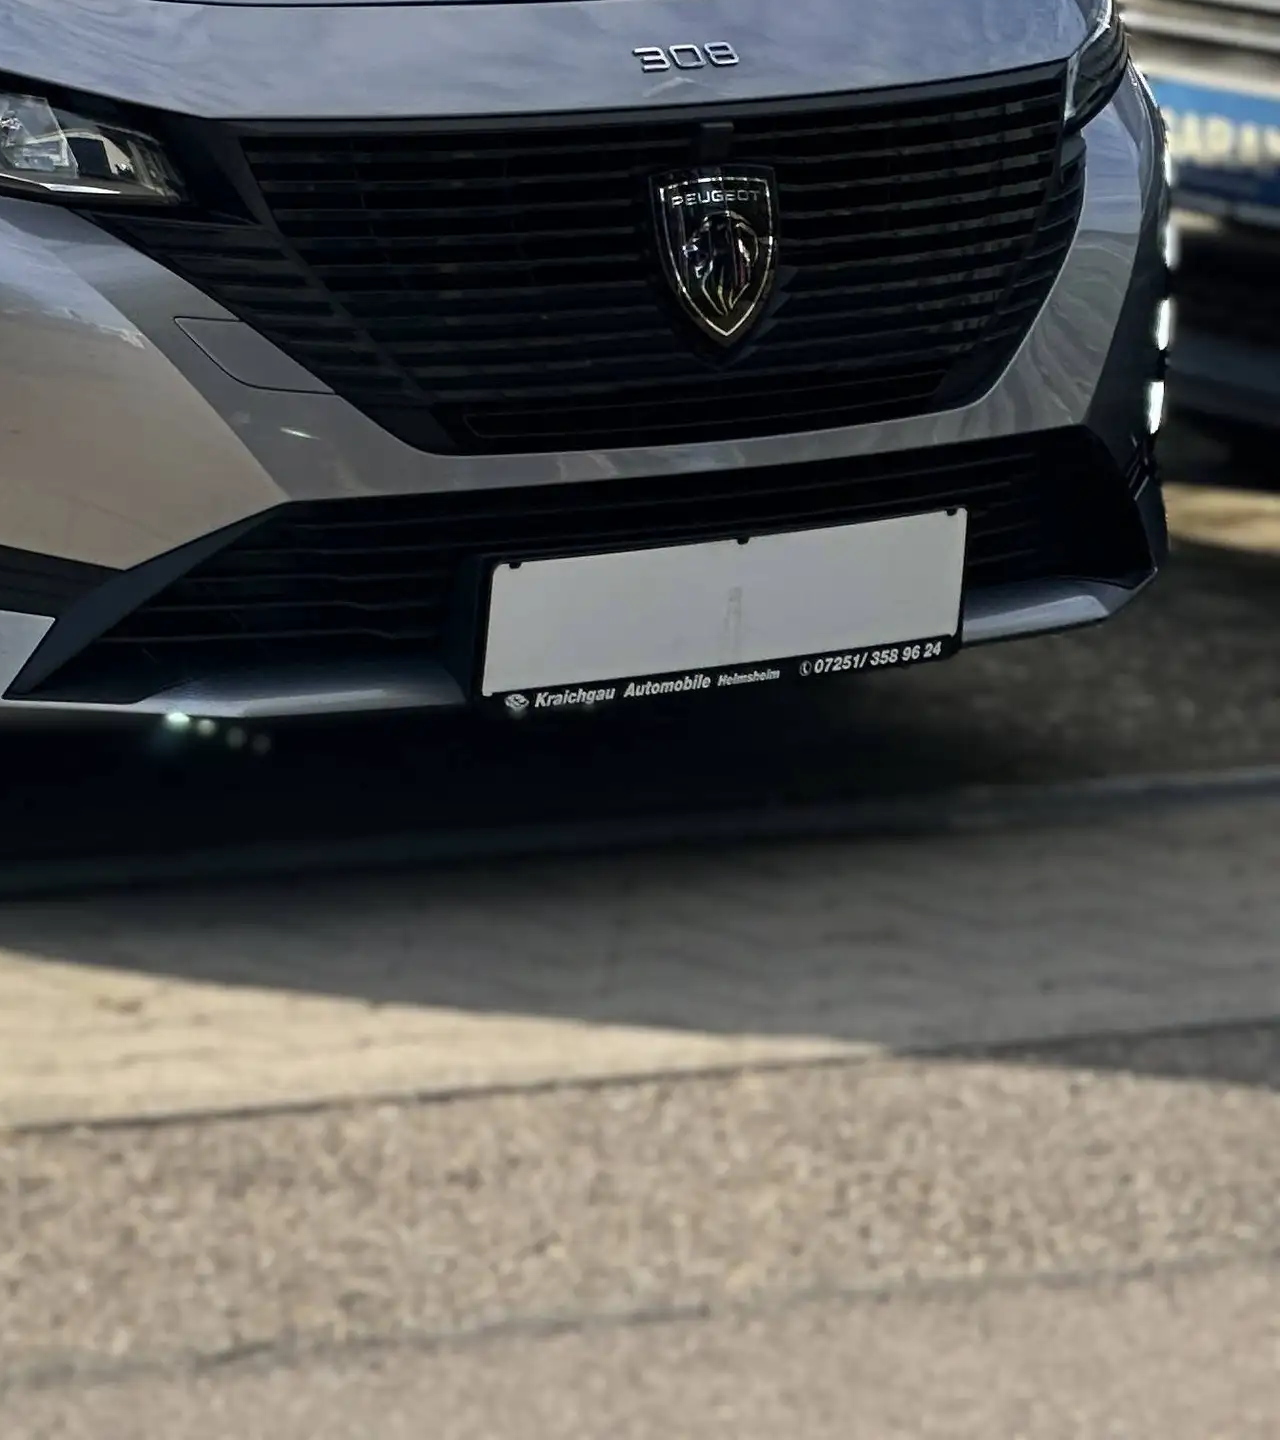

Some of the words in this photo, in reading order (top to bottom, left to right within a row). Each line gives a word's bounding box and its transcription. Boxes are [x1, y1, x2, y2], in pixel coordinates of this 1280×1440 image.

[633, 41, 740, 72] 308
[671, 189, 761, 208] PEUGEOT
[814, 652, 869, 674] 07251/
[869, 648, 898, 667] 358
[900, 644, 921, 662] 96
[922, 641, 942, 658] 24
[534, 686, 616, 709] Kraichgau
[623, 673, 712, 699] Automobile
